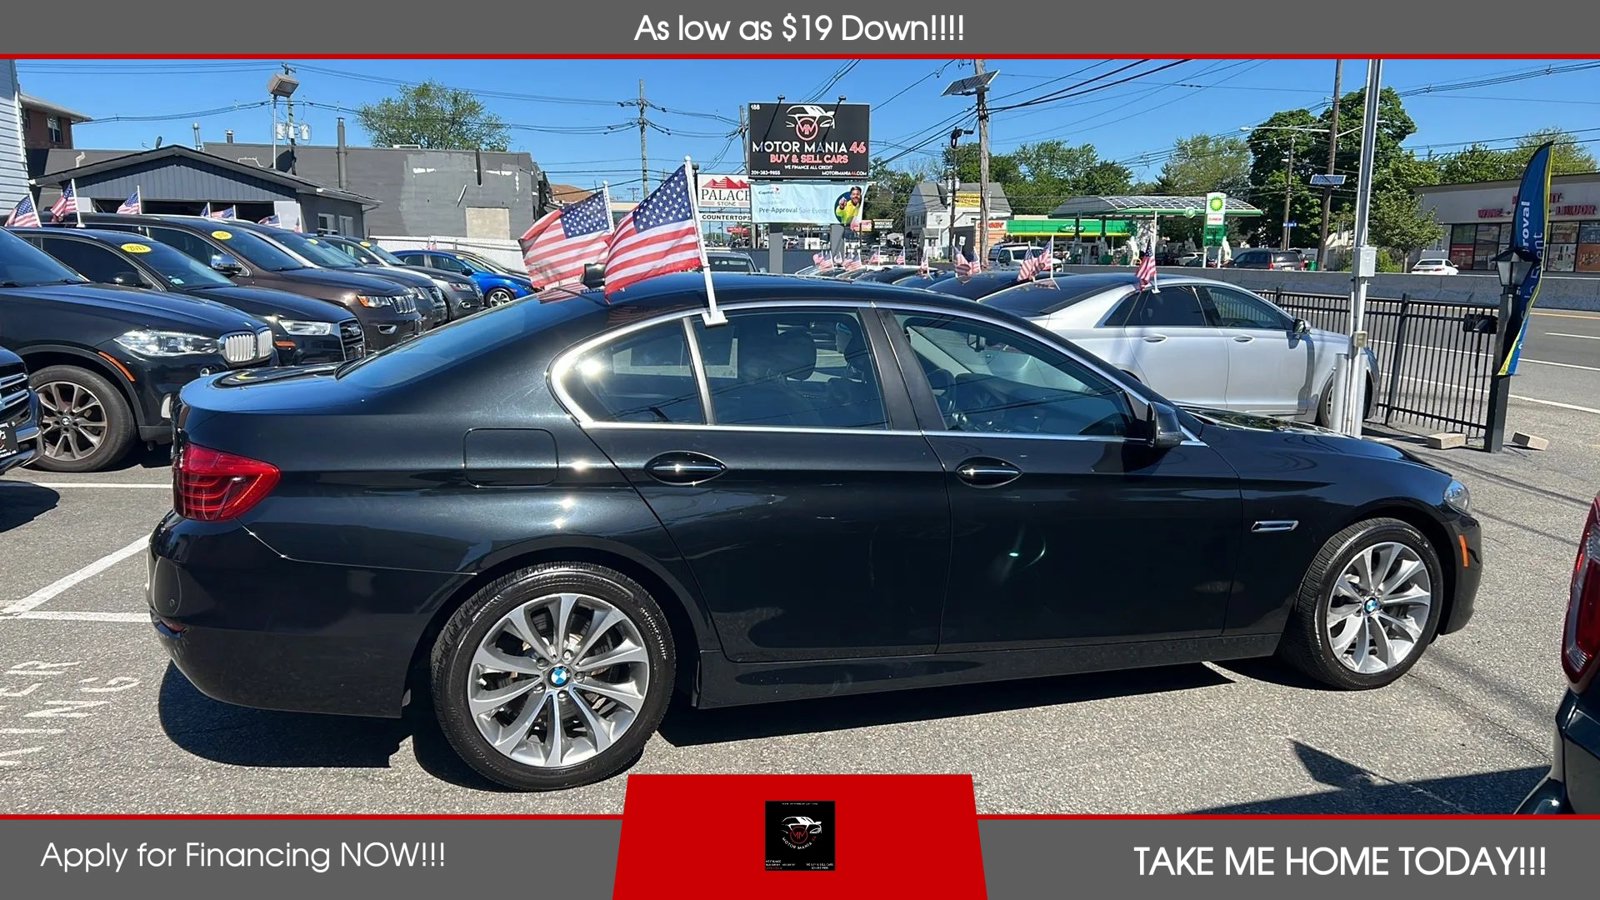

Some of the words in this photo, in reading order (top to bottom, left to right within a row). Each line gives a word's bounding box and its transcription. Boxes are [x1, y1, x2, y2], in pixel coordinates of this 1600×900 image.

[752, 141, 800, 153] MOTOR
[804, 141, 848, 153] MANIA
[849, 141, 867, 154] 46
[769, 154, 790, 163] BUY
[791, 154, 799, 163] &
[800, 154, 823, 163] SELL
[823, 154, 849, 164] CARS
[758, 206, 798, 214] Pre-Approval
